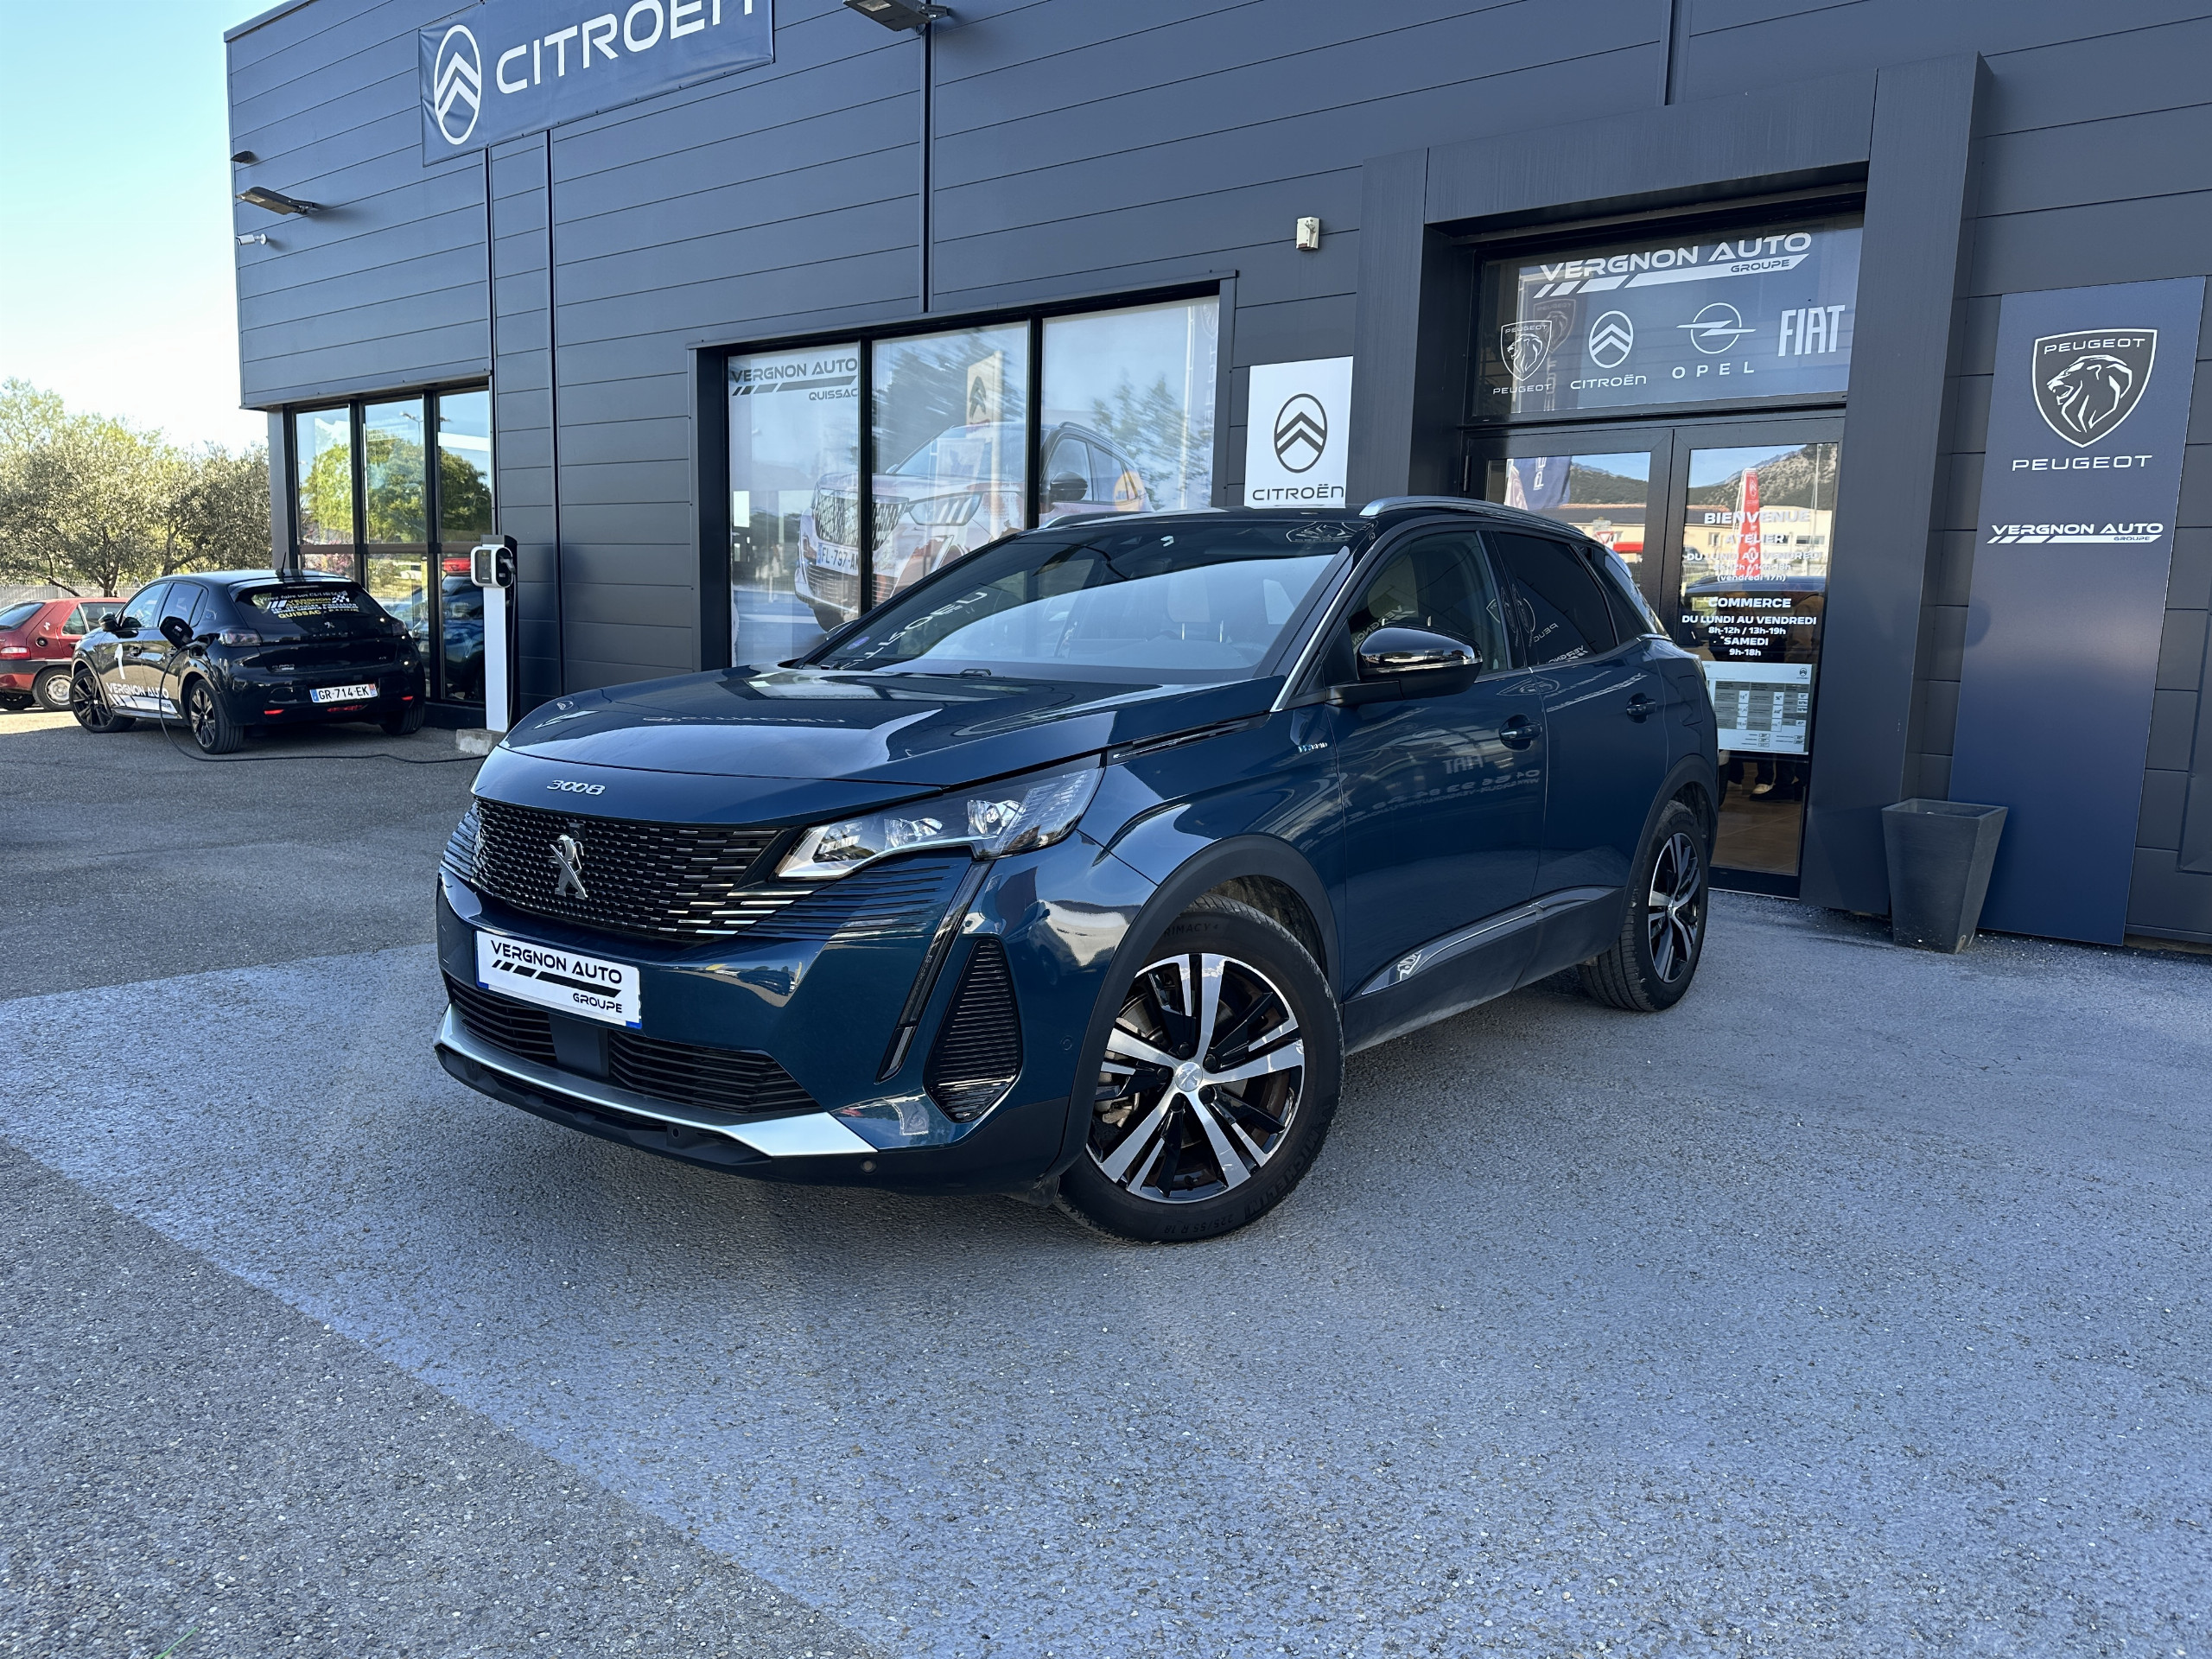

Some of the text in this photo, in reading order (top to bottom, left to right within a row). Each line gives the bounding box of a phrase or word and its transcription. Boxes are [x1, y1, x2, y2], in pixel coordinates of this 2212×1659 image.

[1540, 232, 1812, 282] VERGNON AUTO
[1730, 258, 1790, 273] GROUPE
[1504, 325, 1548, 334] PEUGEOT
[1777, 304, 1846, 357] FIAT
[2044, 338, 2145, 355] PEUGEOT
[731, 358, 858, 383] VERGNON AUTO
[1671, 361, 1755, 379] OPEL
[1492, 383, 1552, 395] PEUGEOT
[1570, 374, 1647, 391] CITROËN
[809, 387, 858, 401] QUISSAC
[2012, 455, 2152, 471] PEUGEOT
[1253, 484, 1344, 501] CITROËN
[1704, 510, 1811, 524] BIENVENUE
[1992, 523, 2164, 535] VERGNON AUTO
[1726, 534, 1784, 544] ATELIER
[1708, 598, 1792, 608] COMMERCE
[1681, 615, 1698, 624] DU
[1700, 615, 1735, 624] LUNDI
[1756, 616, 1817, 625] VENDREDI
[1708, 626, 1740, 635] 8h-12h
[1749, 626, 1787, 635] 13h-19h
[1724, 637, 1769, 645] SAMEDI
[105, 682, 169, 699] VERGNON AUTO
[546, 779, 606, 796] 3008
[491, 939, 623, 984] VERGNON AUTO
[572, 993, 623, 1014] GROUPE
